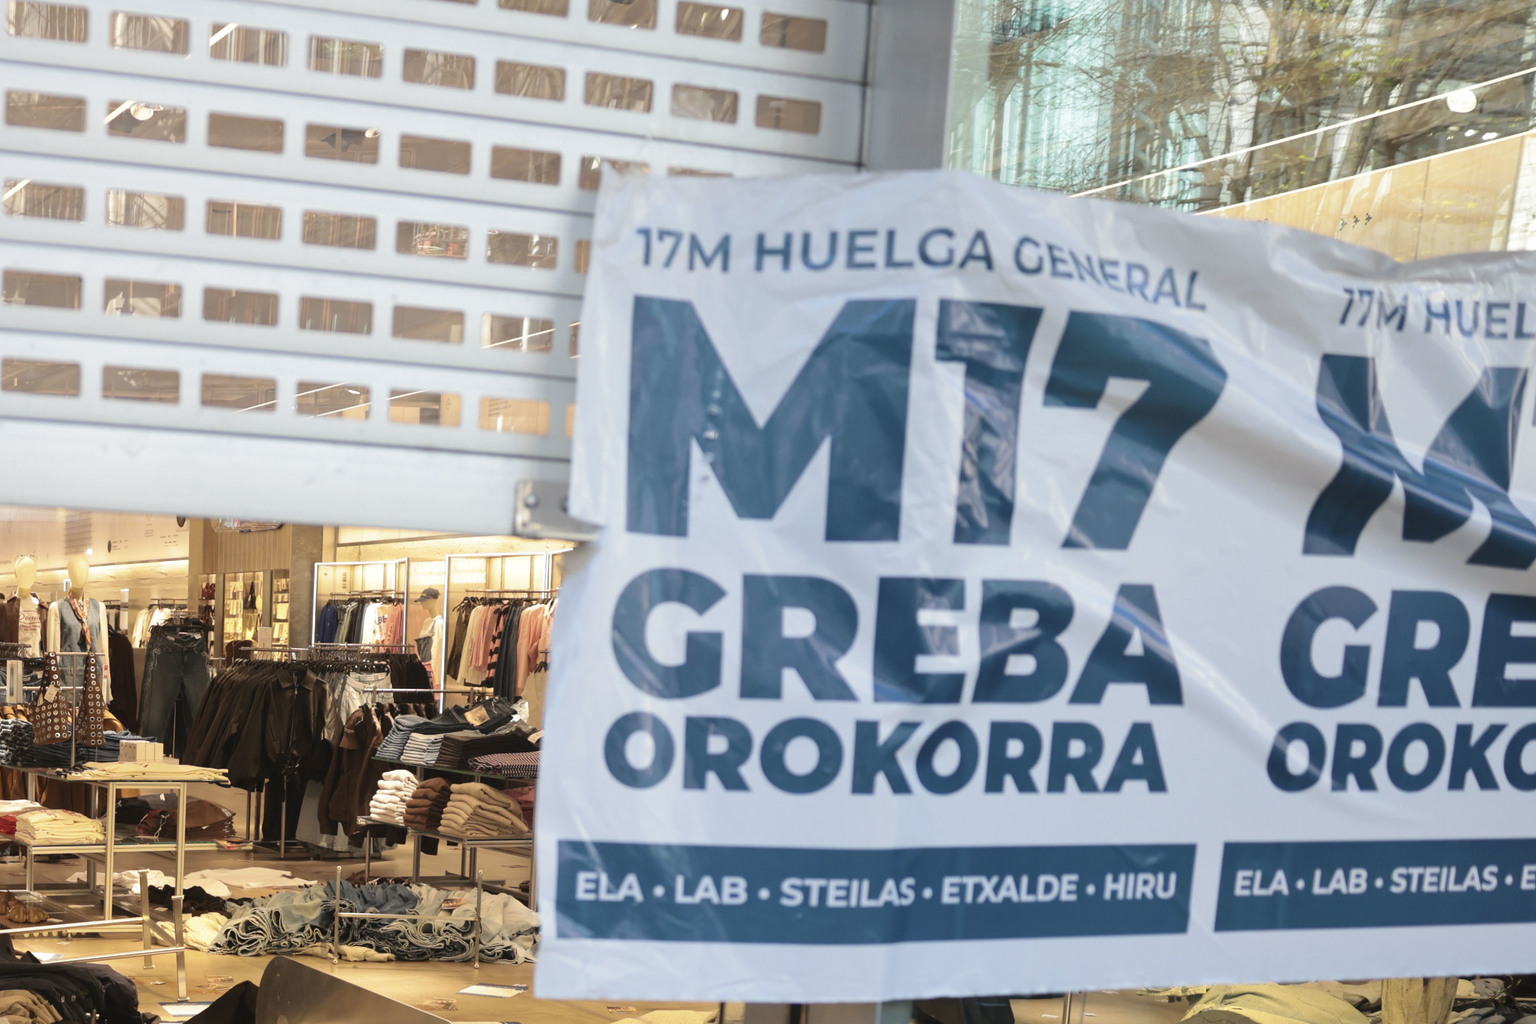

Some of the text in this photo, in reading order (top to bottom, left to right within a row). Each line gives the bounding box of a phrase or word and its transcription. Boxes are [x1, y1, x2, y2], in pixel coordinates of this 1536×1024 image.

[635, 226, 1208, 312] 17M HUELGA GENERAL
[626, 294, 1229, 551] M17
[610, 567, 1184, 707] GREBA
[1280, 585, 1536, 711] GRE
[602, 715, 1170, 796] OROKORRA
[575, 870, 1178, 909] ELA LAB STEILAS ETXALDE HIRU
[1234, 868, 1290, 897] ELA
[1311, 867, 1368, 896] LAB
[1389, 864, 1499, 894] STEILAS
